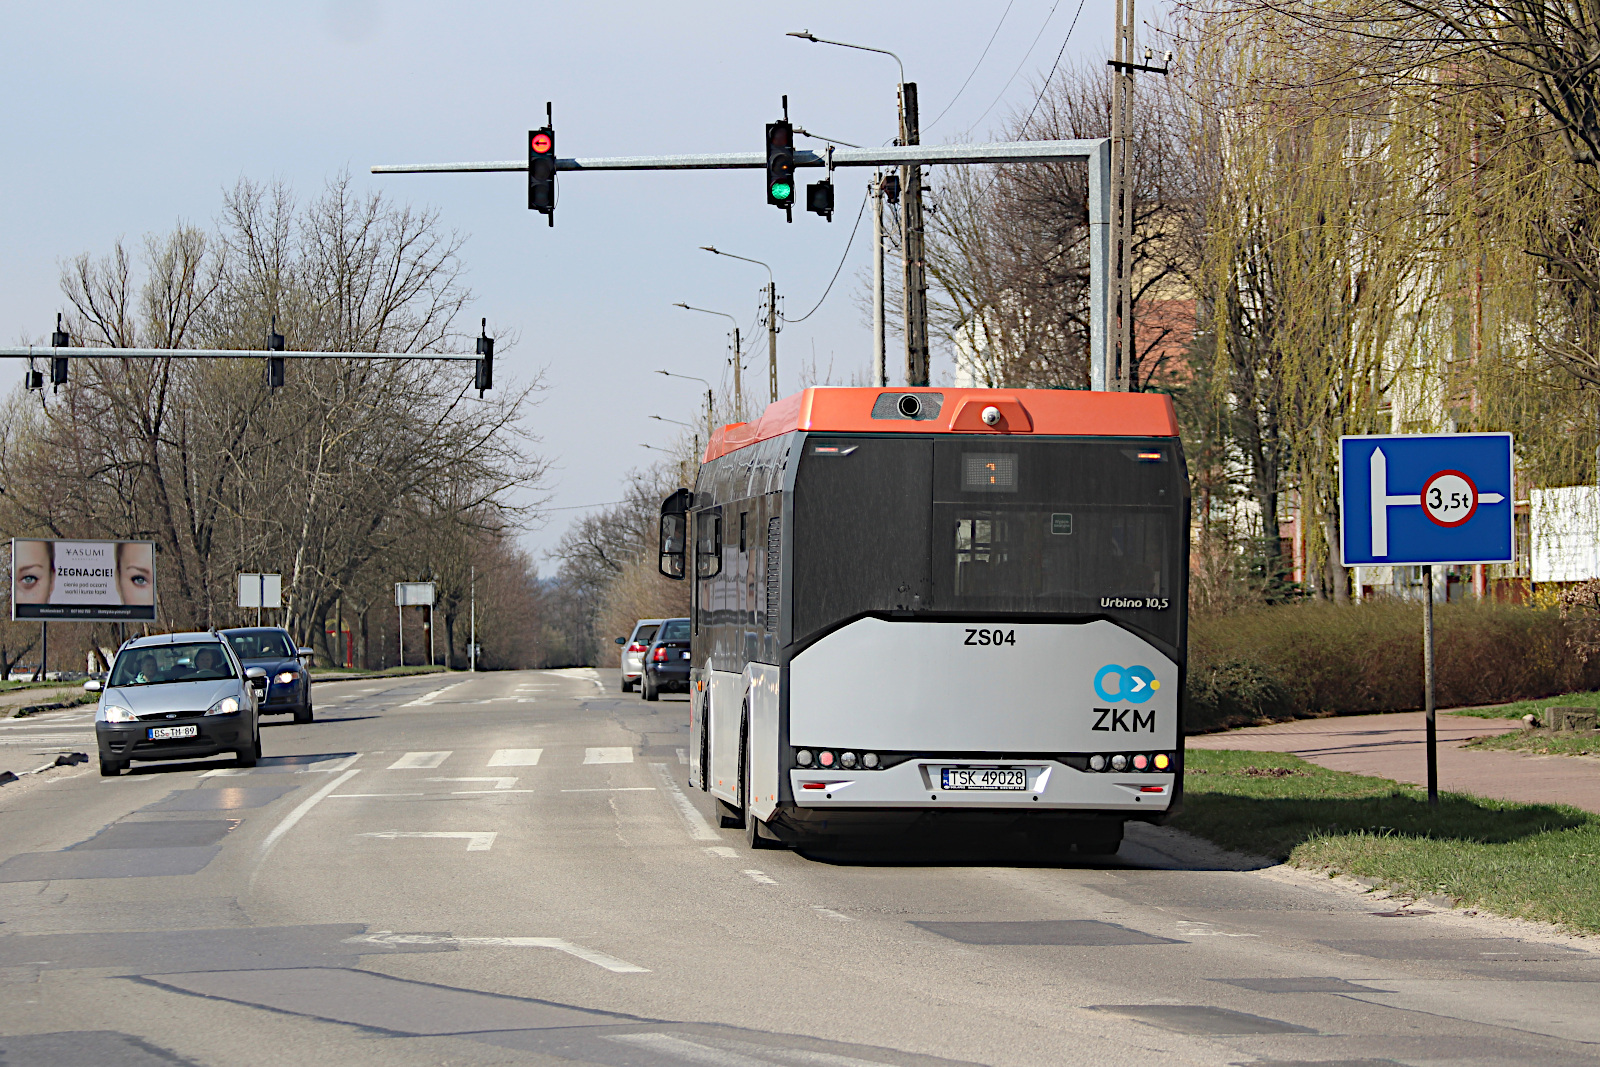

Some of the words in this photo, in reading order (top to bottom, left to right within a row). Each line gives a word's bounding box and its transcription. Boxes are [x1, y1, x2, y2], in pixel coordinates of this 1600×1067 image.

[1428, 488, 1469, 511] 3,5t
[58, 566, 113, 577] ŻEGNAJCIE!
[1100, 597, 1143, 609] Urbino
[1144, 597, 1169, 610] 10,5
[964, 629, 1016, 646] ZS04
[1091, 708, 1156, 733] ZKM
[154, 729, 165, 738] BS
[184, 727, 195, 735] 89
[950, 771, 976, 785] TSK
[981, 771, 1023, 785] 49028
